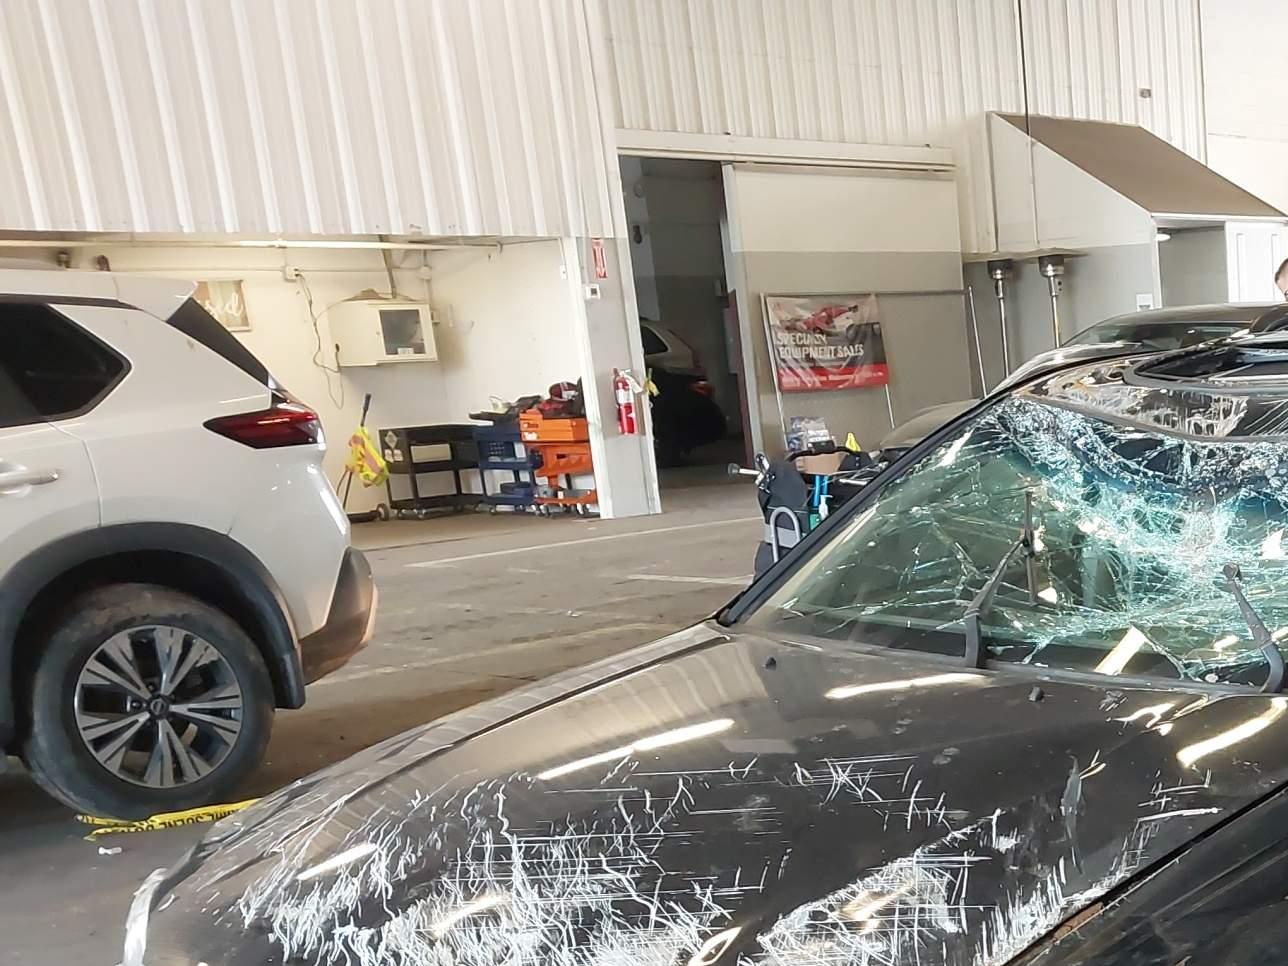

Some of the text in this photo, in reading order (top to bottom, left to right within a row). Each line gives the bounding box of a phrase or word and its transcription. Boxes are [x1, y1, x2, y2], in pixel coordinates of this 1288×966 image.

[777, 332, 827, 345] SPECIALTY
[779, 344, 864, 359] EQUIPMENT SALES
